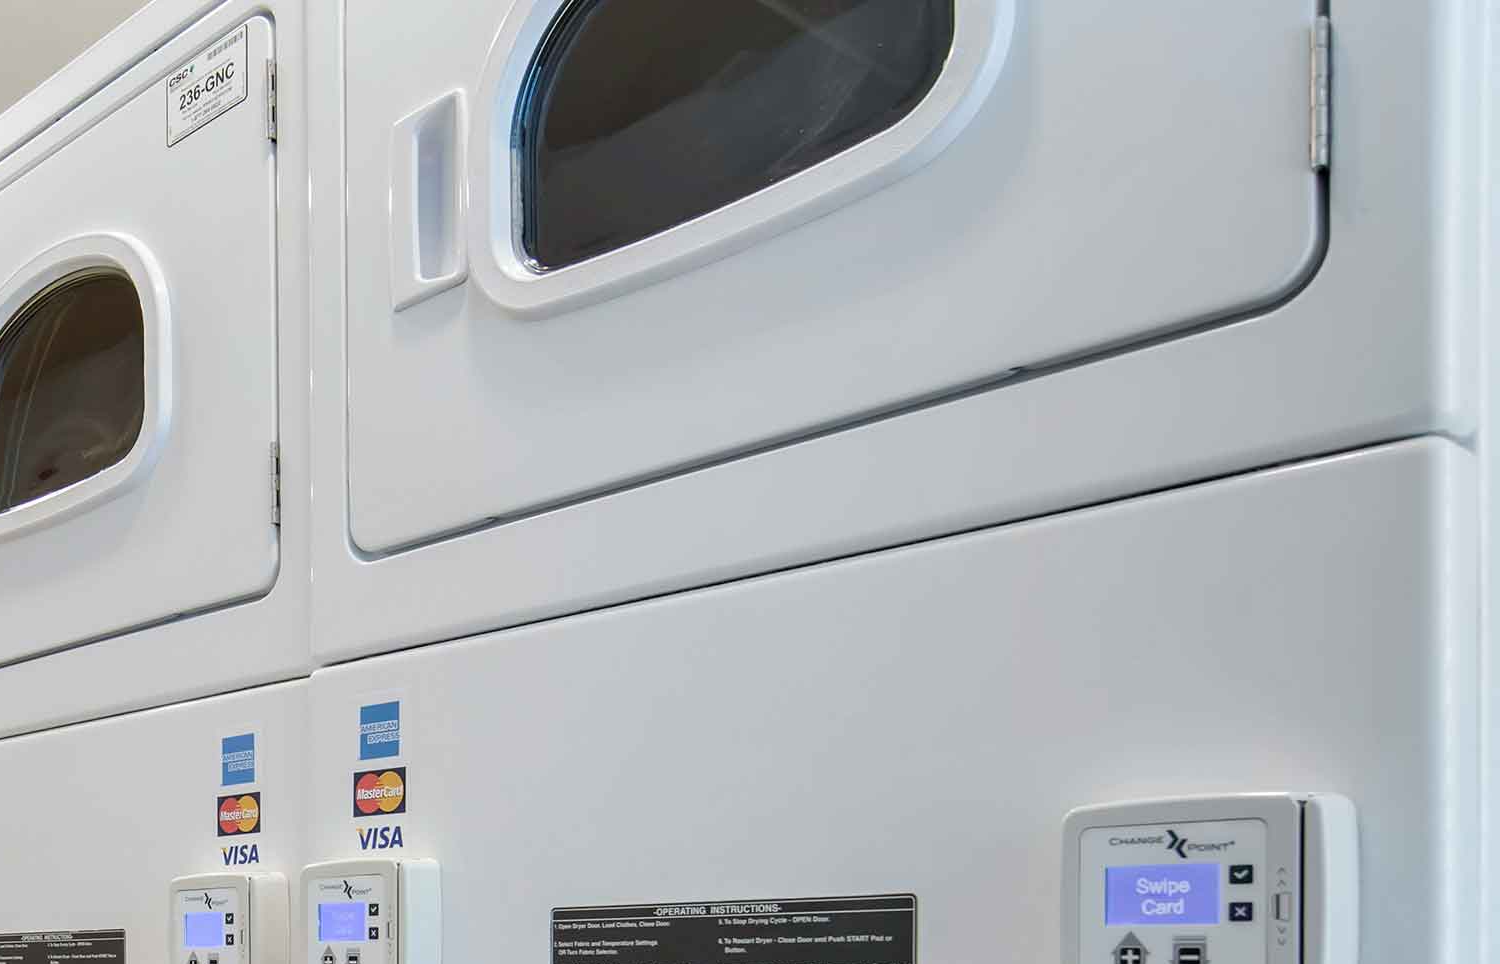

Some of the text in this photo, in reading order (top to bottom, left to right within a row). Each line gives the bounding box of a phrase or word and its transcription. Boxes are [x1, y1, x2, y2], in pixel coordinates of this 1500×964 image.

[169, 69, 188, 88] CSC
[180, 62, 235, 111] 236-GNC
[360, 721, 398, 734] AMERICAN
[367, 731, 401, 745] EXPRESS
[357, 786, 403, 801] MasterCard
[357, 826, 404, 850] VISA
[221, 844, 260, 866] VISA
[1135, 877, 1191, 897] Swipe
[1141, 898, 1185, 916] Card
